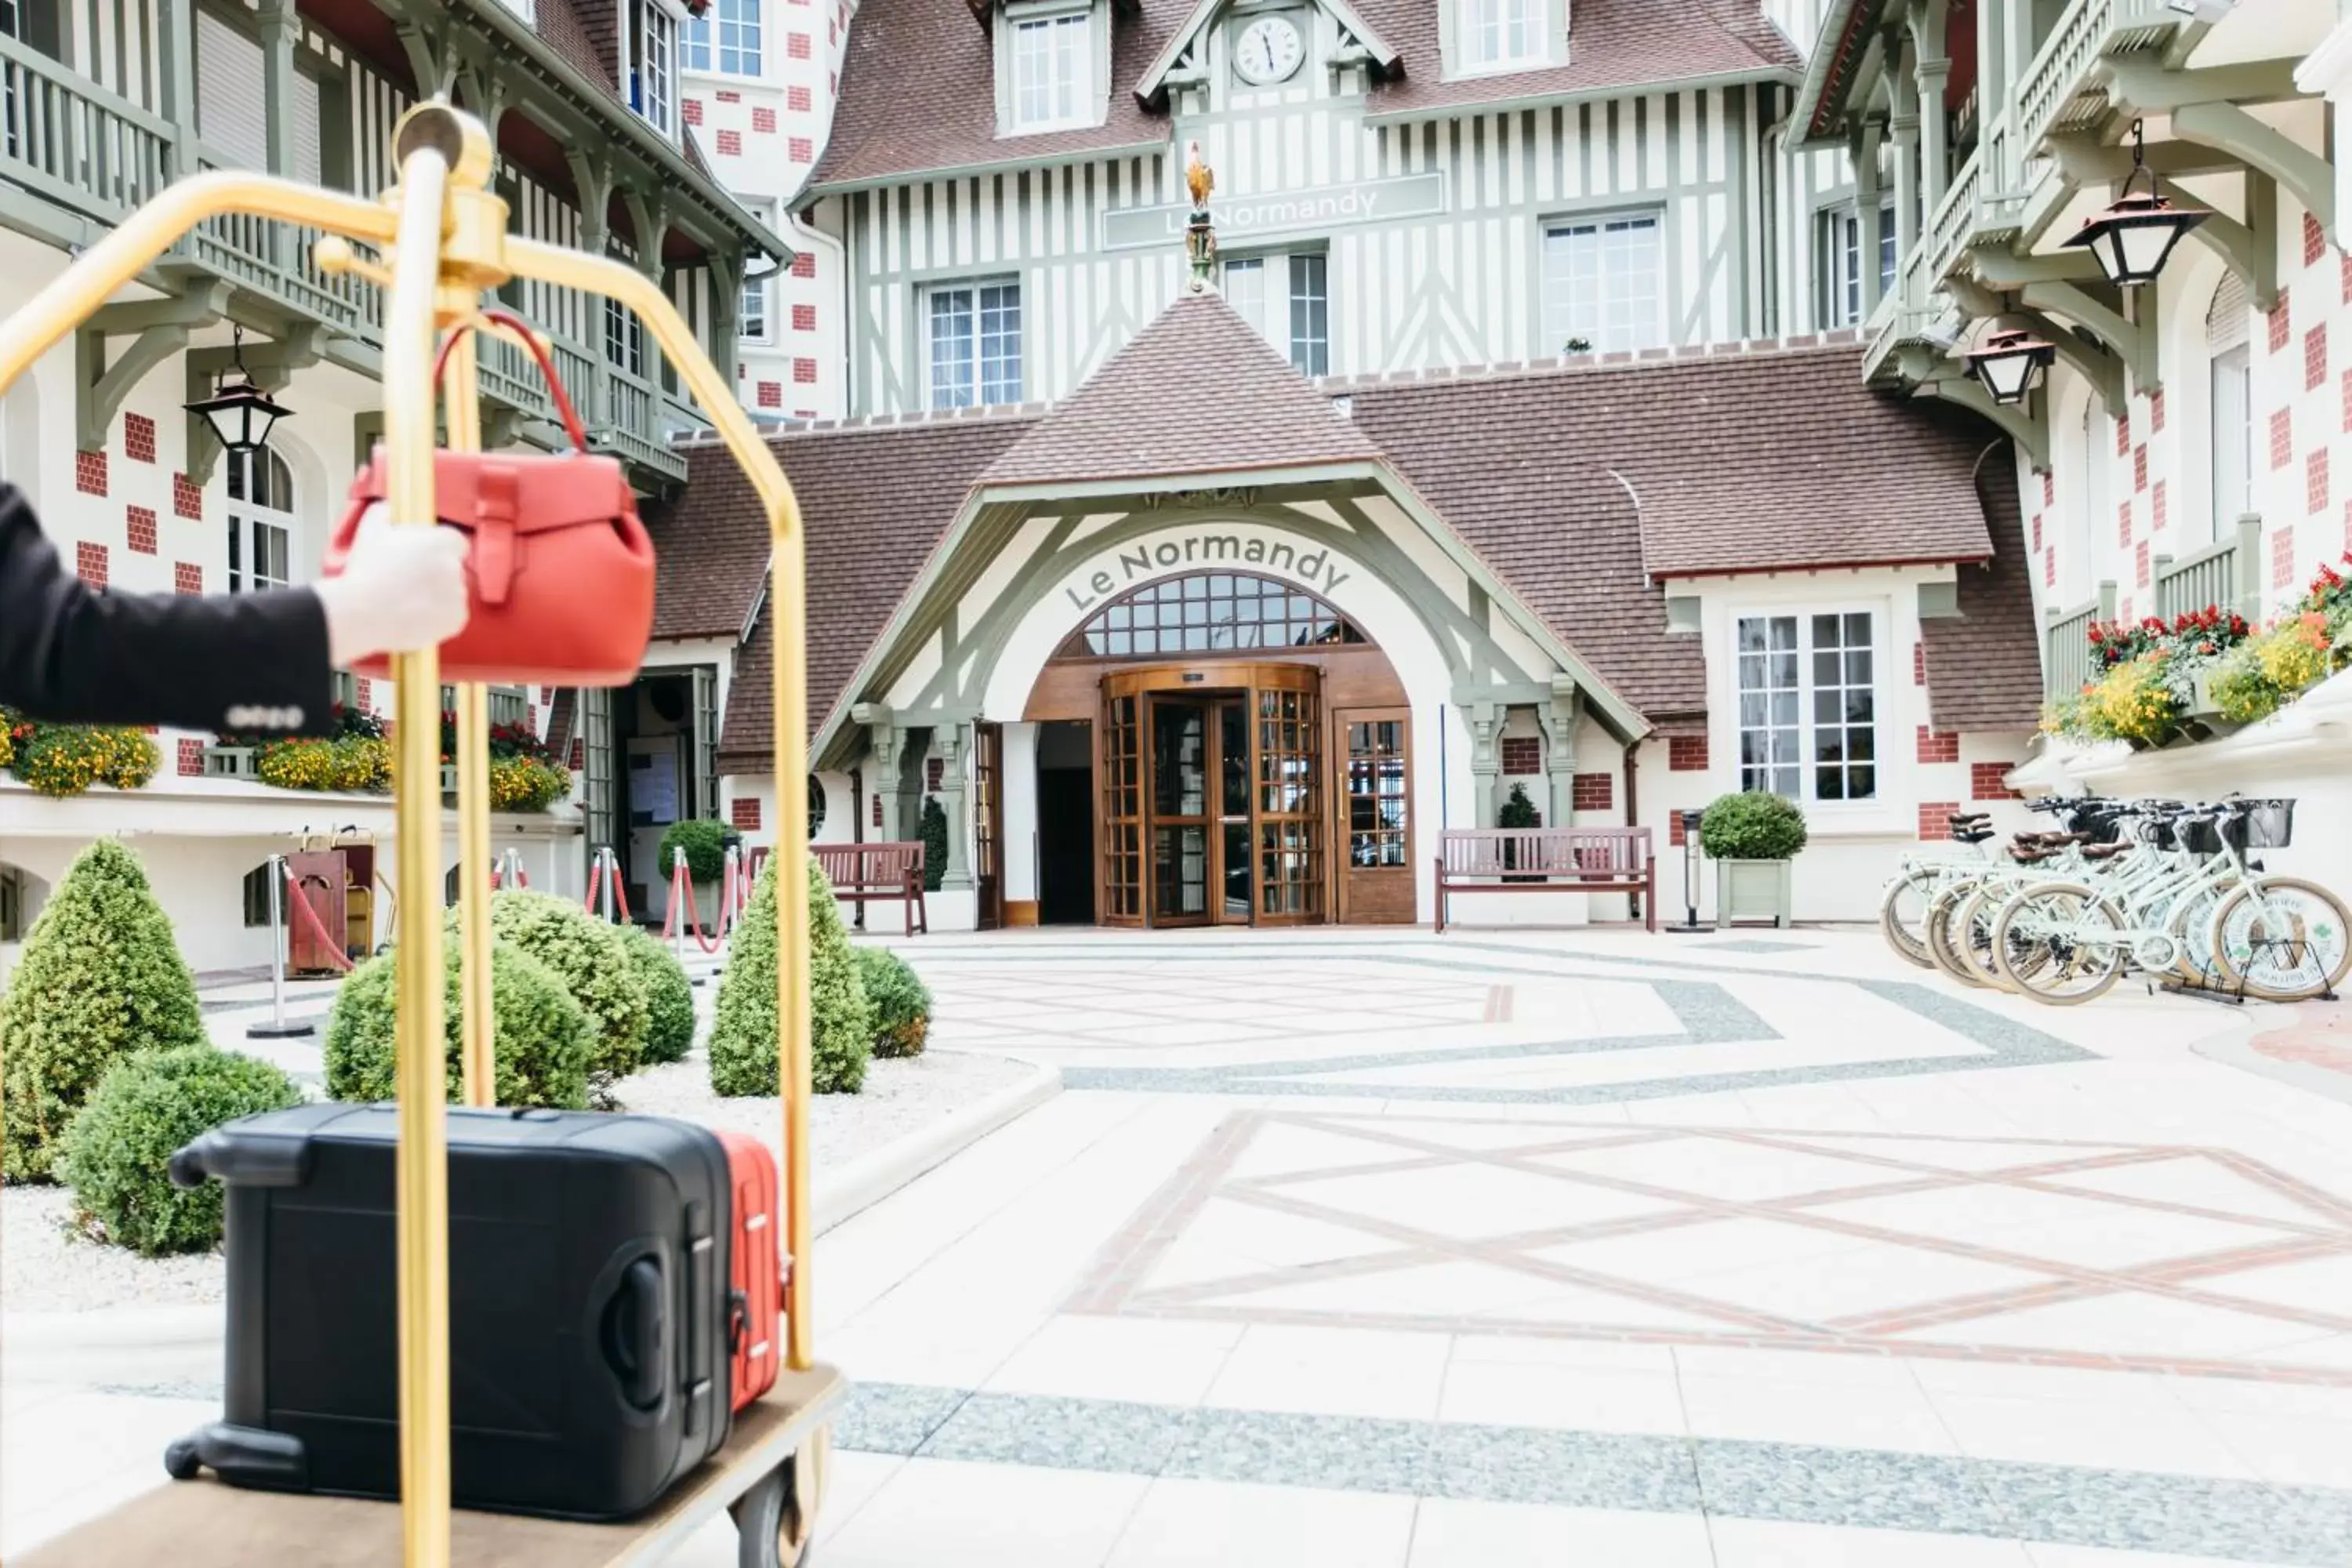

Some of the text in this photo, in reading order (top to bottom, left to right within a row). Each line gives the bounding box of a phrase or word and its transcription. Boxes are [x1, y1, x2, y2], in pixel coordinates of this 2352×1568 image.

[1211, 189, 1377, 227] Normandy
[1065, 535, 1350, 612] Le Normandy
